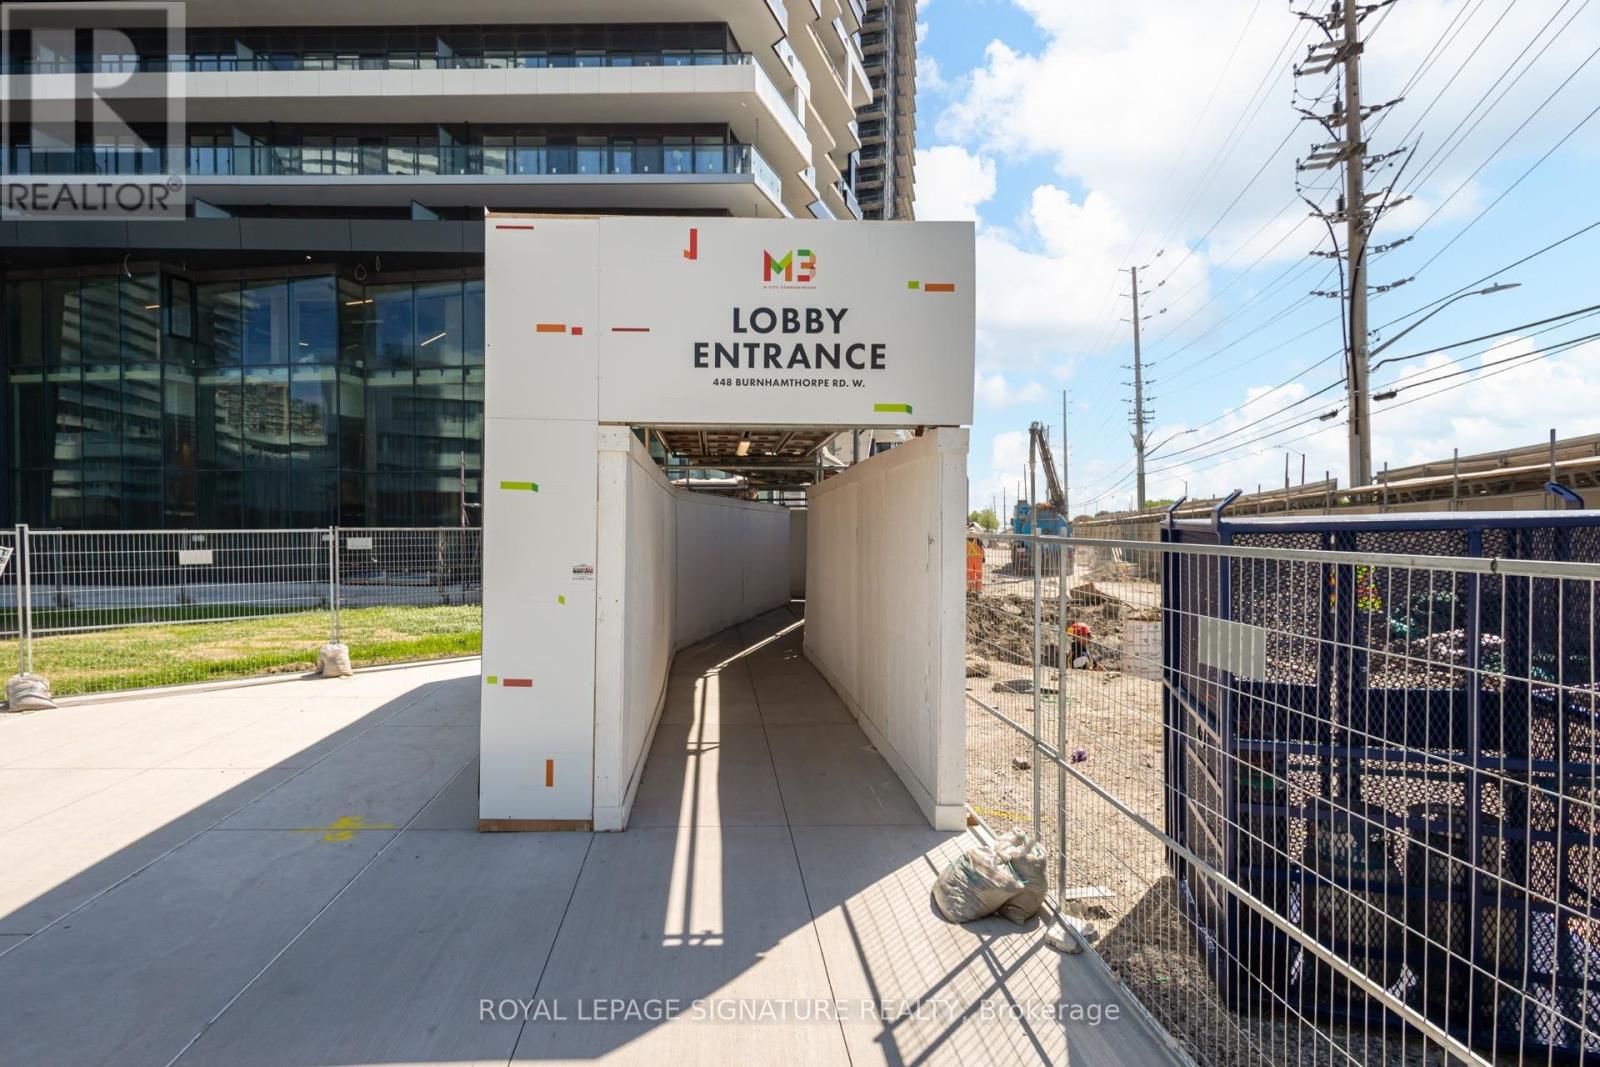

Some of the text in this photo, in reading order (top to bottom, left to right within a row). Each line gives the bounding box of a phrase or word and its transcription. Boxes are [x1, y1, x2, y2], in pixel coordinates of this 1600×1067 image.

[733, 307, 848, 334] LOBBY
[694, 342, 886, 370] ENTRANCE
[712, 378, 866, 388] 448 BURNHAMTHORPE RD. W.
